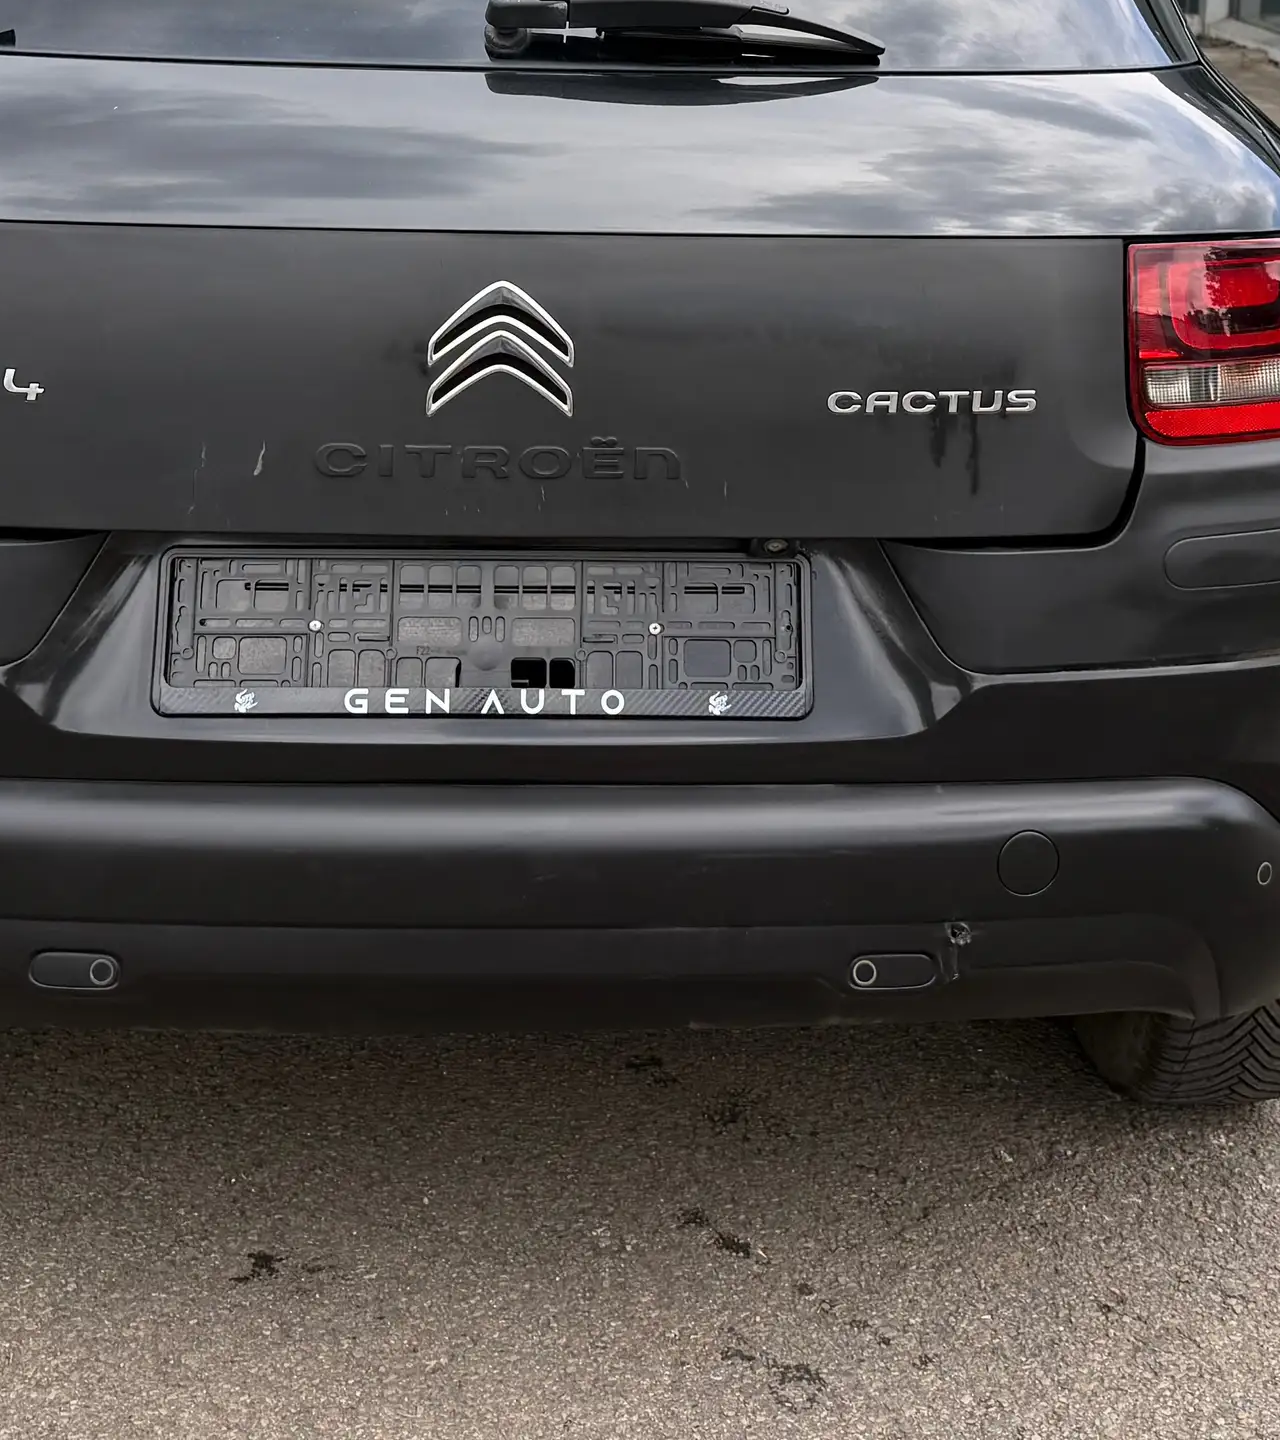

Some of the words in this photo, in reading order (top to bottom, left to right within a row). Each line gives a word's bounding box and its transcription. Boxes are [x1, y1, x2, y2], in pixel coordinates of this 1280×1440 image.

[827, 389, 1037, 414] CACTUS
[316, 436, 682, 480] CITROËN
[344, 688, 451, 714] GEN
[480, 688, 625, 715] AUTO
